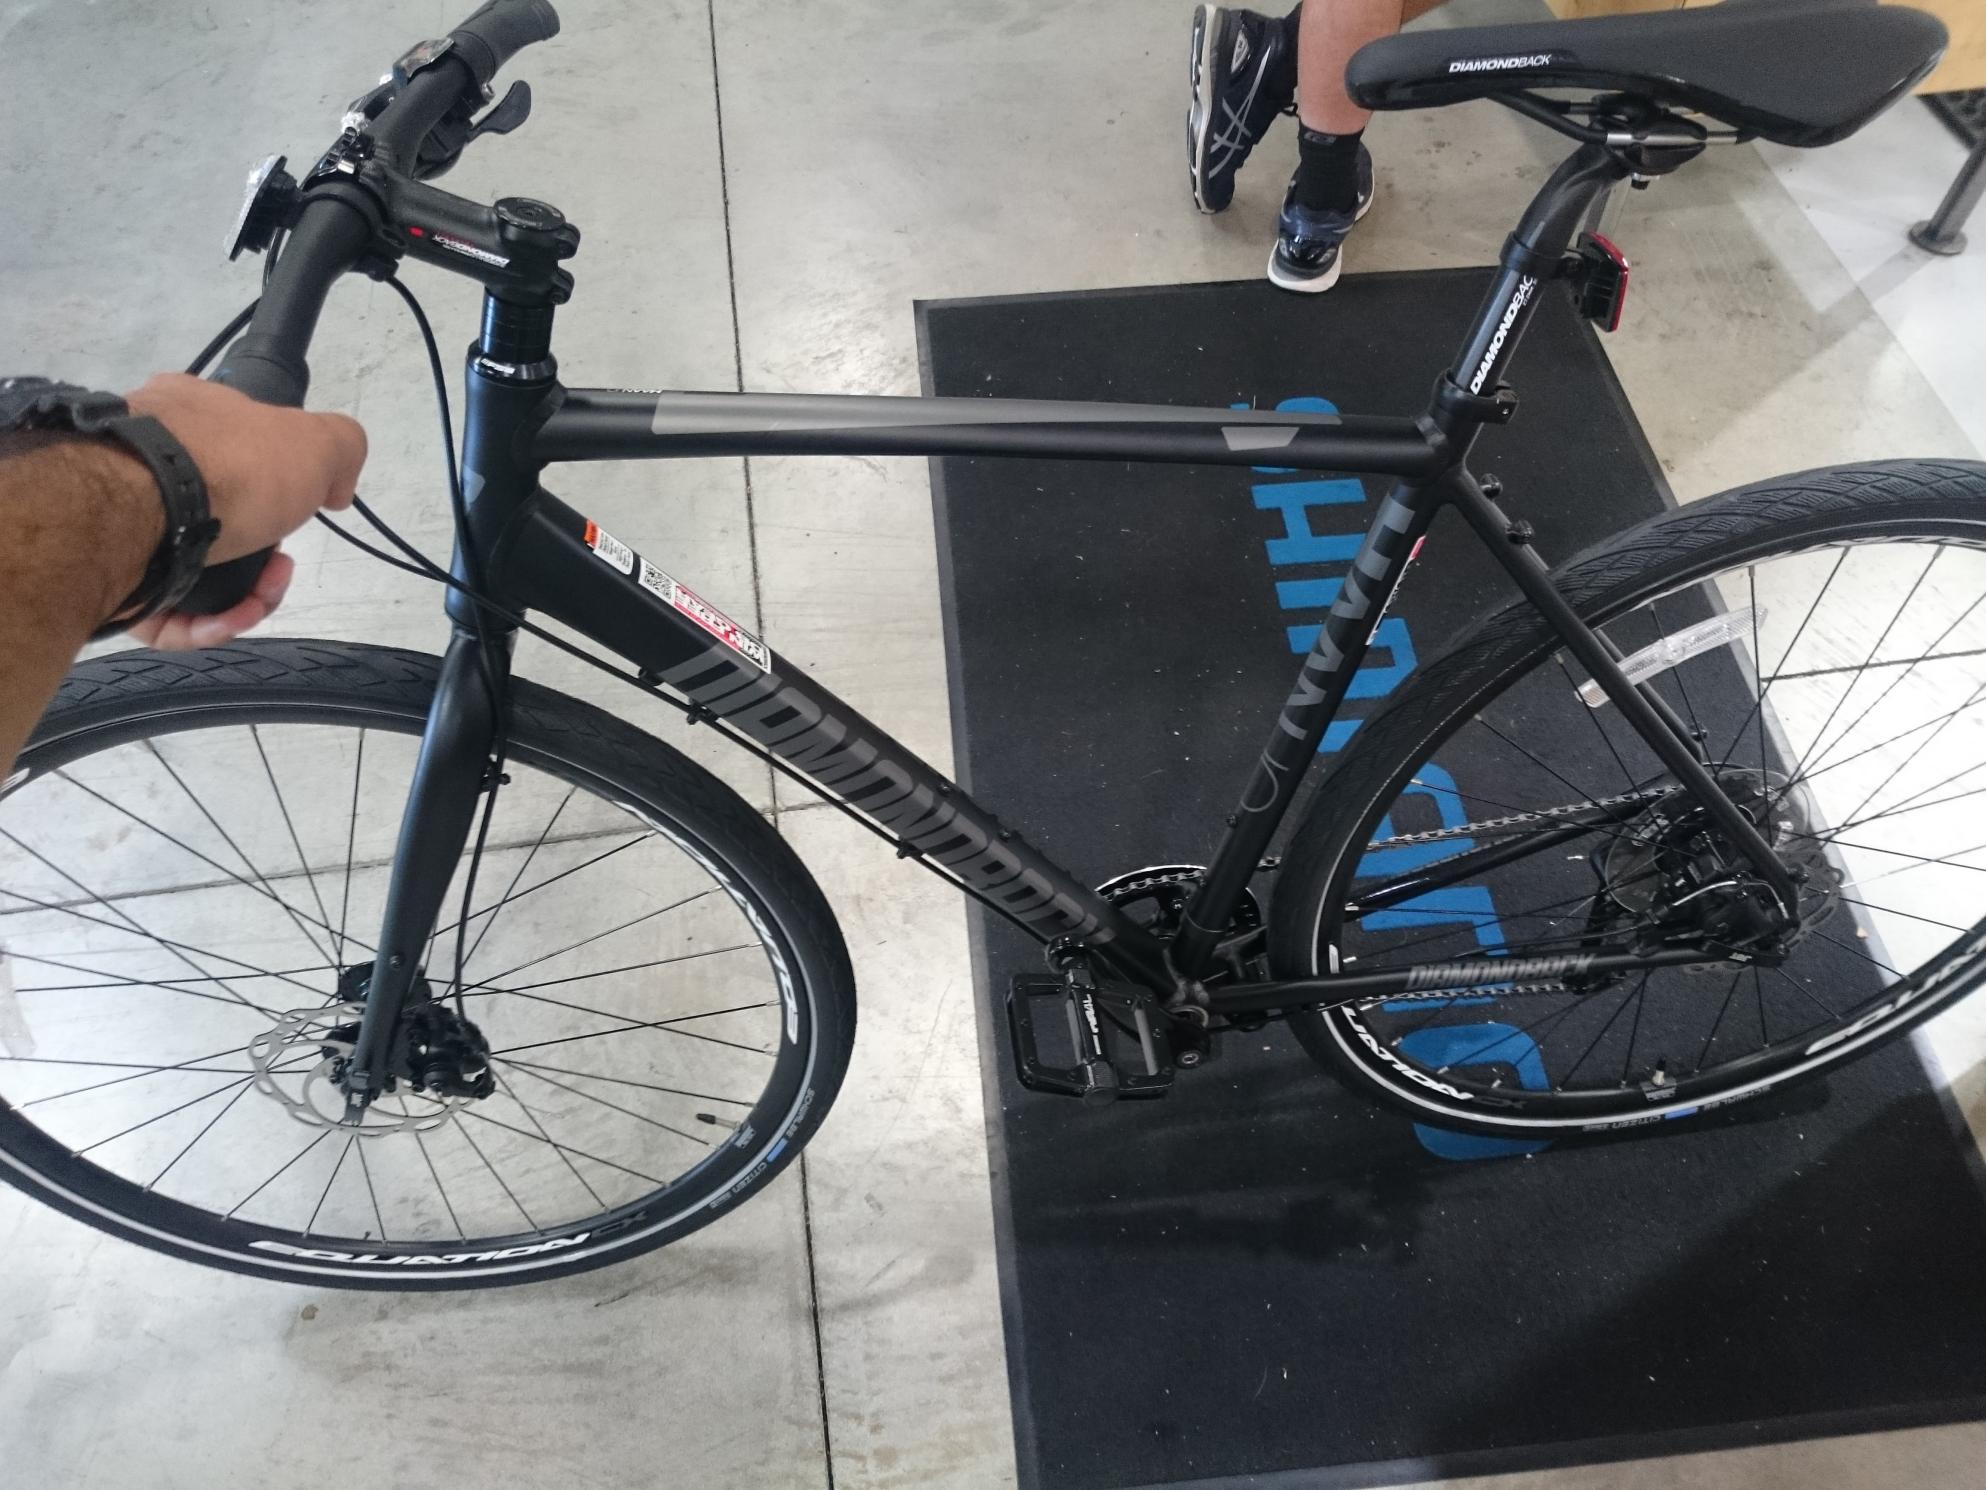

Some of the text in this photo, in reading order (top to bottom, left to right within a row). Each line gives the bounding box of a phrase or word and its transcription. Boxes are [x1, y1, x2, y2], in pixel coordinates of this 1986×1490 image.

[1448, 53, 1553, 73] DIAMONDBACK
[1470, 274, 1535, 394] DIAMONDBAC
[659, 642, 1115, 944] DIAMONDBACK
[1407, 953, 1594, 990] DIAMONDBACK
[249, 1232, 591, 1265] EQUATION
